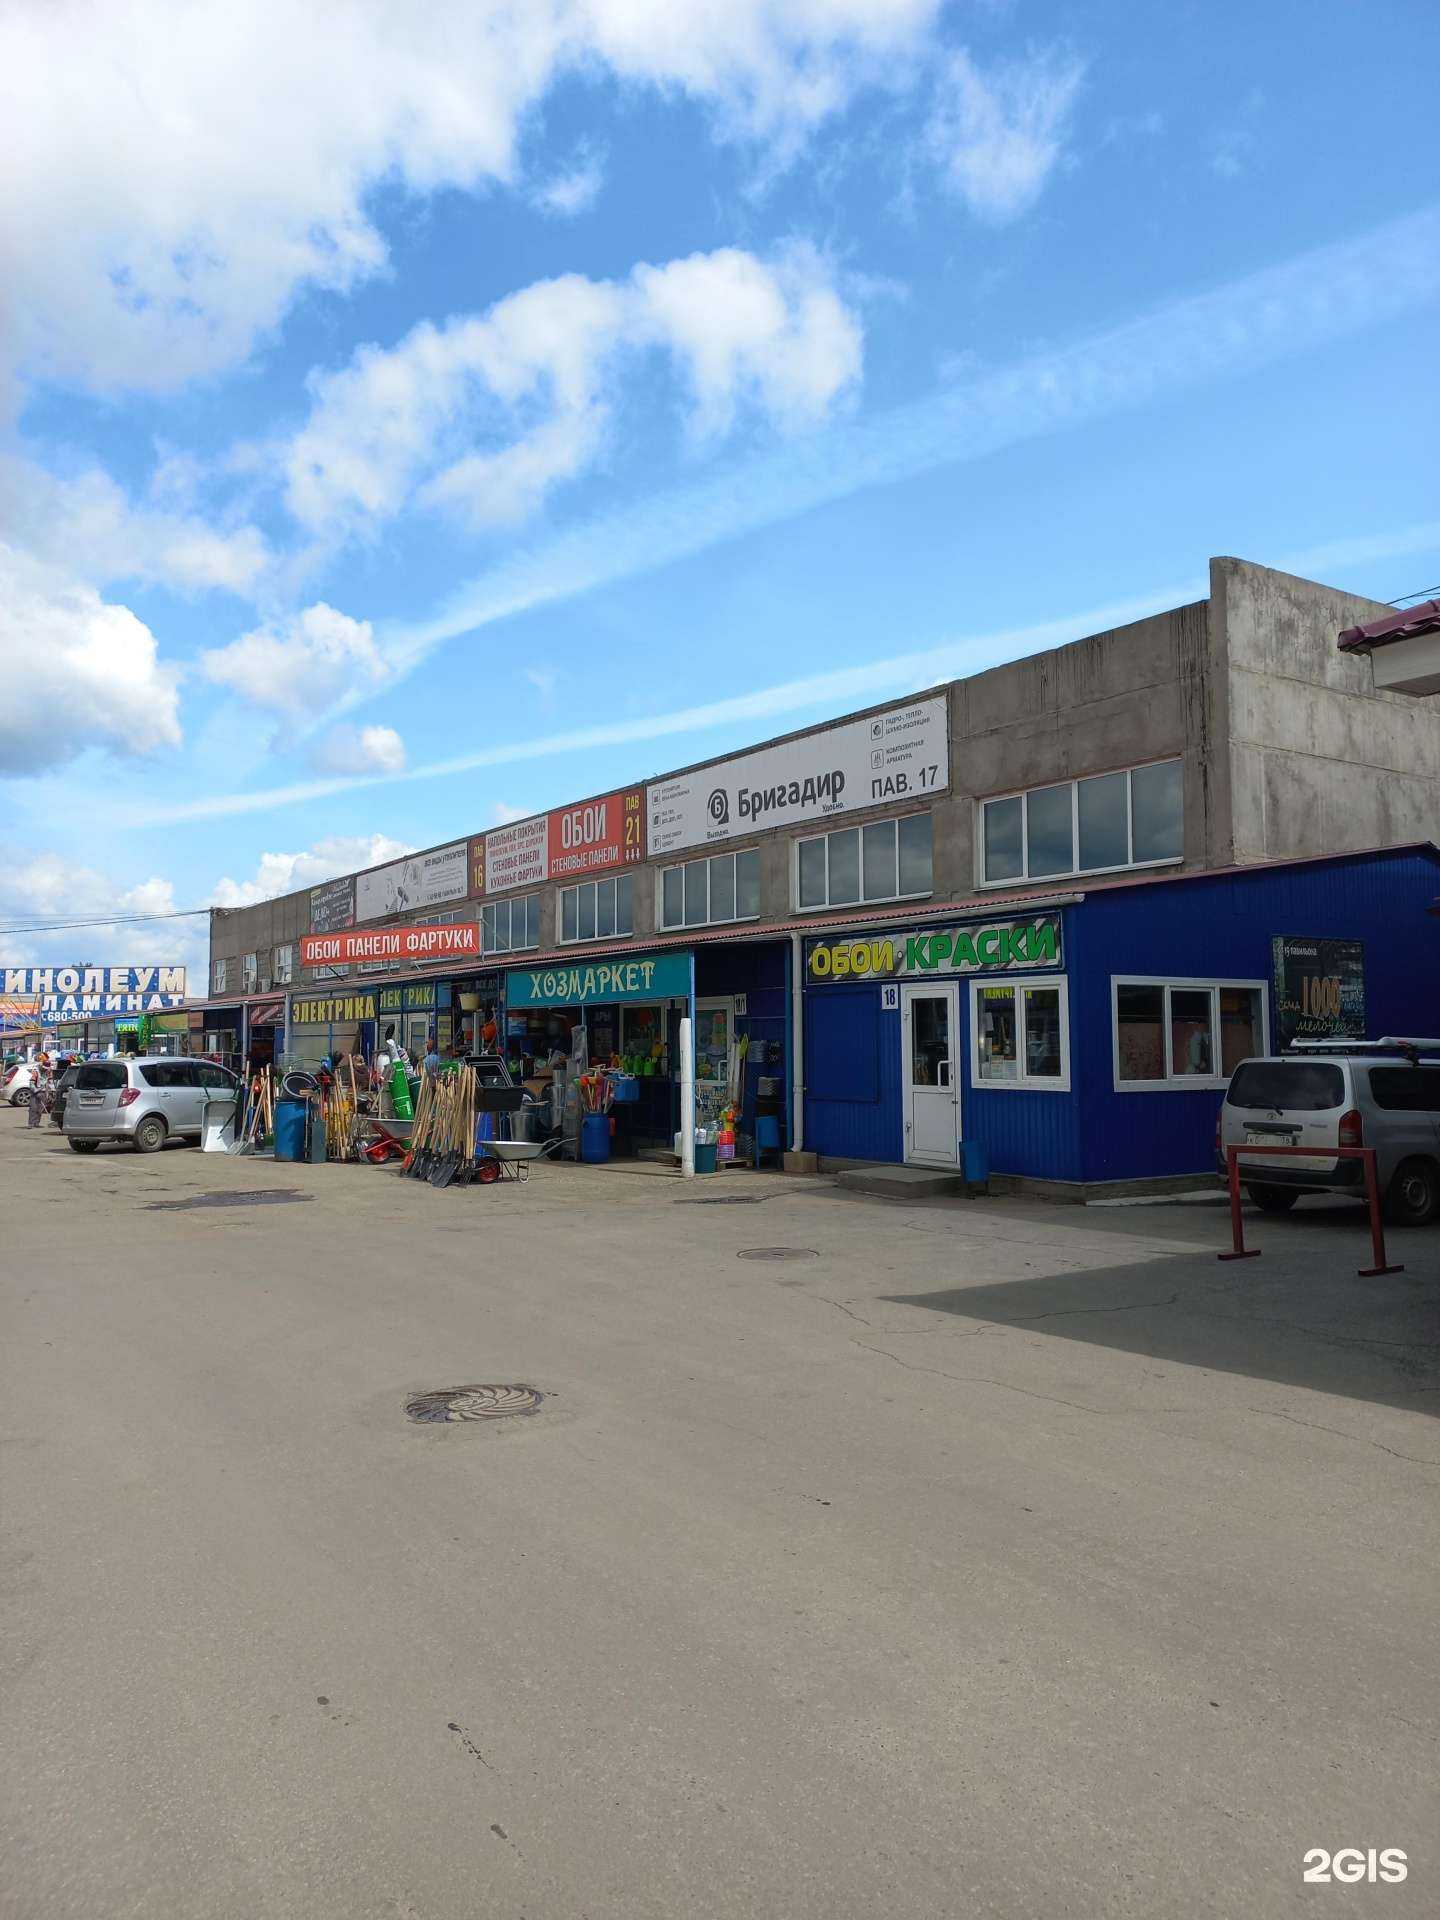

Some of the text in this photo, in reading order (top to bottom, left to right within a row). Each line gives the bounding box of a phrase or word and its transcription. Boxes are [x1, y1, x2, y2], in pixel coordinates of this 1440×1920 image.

[738, 769, 845, 822] Бригадир
[871, 765, 939, 799] ПАВ. 17
[625, 795, 640, 811] ПАВ
[561, 803, 607, 849] ОБОИ
[625, 815, 641, 845] 21
[518, 849, 540, 866] ПАНЕЛИ
[551, 845, 619, 873] СТЕНОВЫЕ ПАНЕЛИ
[473, 865, 484, 889] 16
[517, 865, 543, 881] ФАРТУКИ
[306, 928, 473, 960] ОБОИ ПАНЕЛИ ФАРТУКИ
[811, 921, 1057, 976] ОБОИ КРАСКИ
[5, 967, 185, 993] ИНОЛЕУМ
[530, 961, 656, 1000] ХОЗМАРКЕТ
[42, 994, 184, 1011] ЛАМИНАТ
[292, 995, 376, 1023] ЭЛЕКТРИКА
[884, 988, 896, 1006] 18
